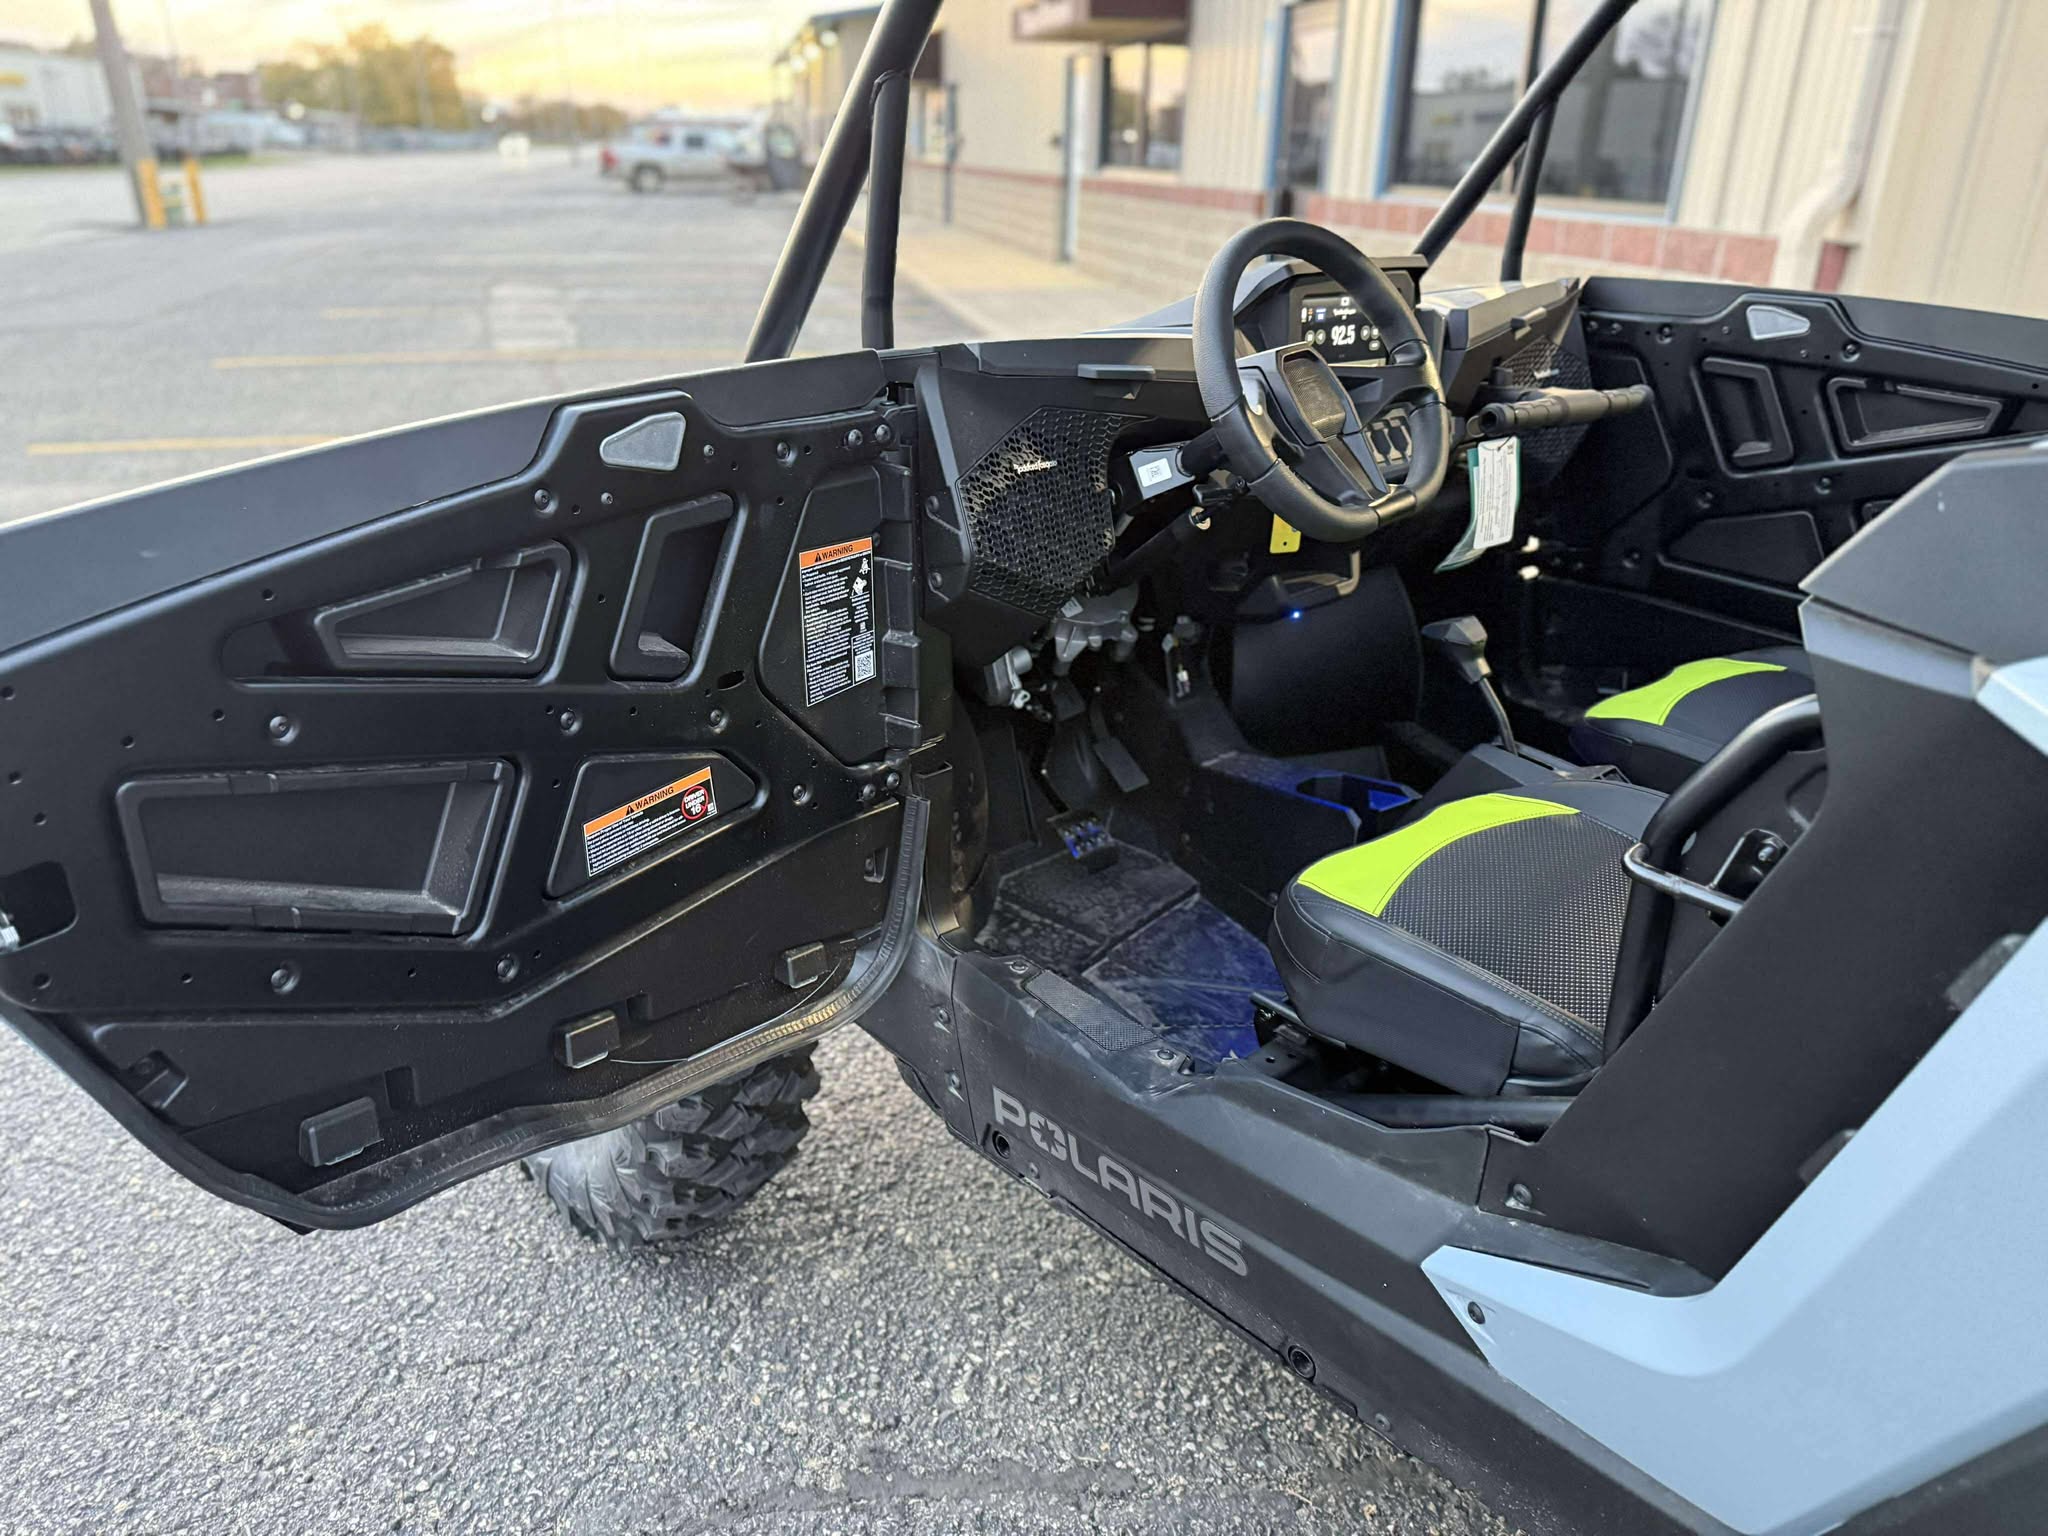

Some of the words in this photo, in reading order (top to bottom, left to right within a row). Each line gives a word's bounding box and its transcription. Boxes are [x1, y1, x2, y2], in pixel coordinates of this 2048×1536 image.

[821, 544, 854, 560] WARNING
[635, 786, 674, 809] WARNING
[684, 790, 705, 803] DRIVER
[685, 796, 705, 809] UNDER
[690, 803, 702, 815] 16
[992, 1086, 1248, 1277] POLARIS
